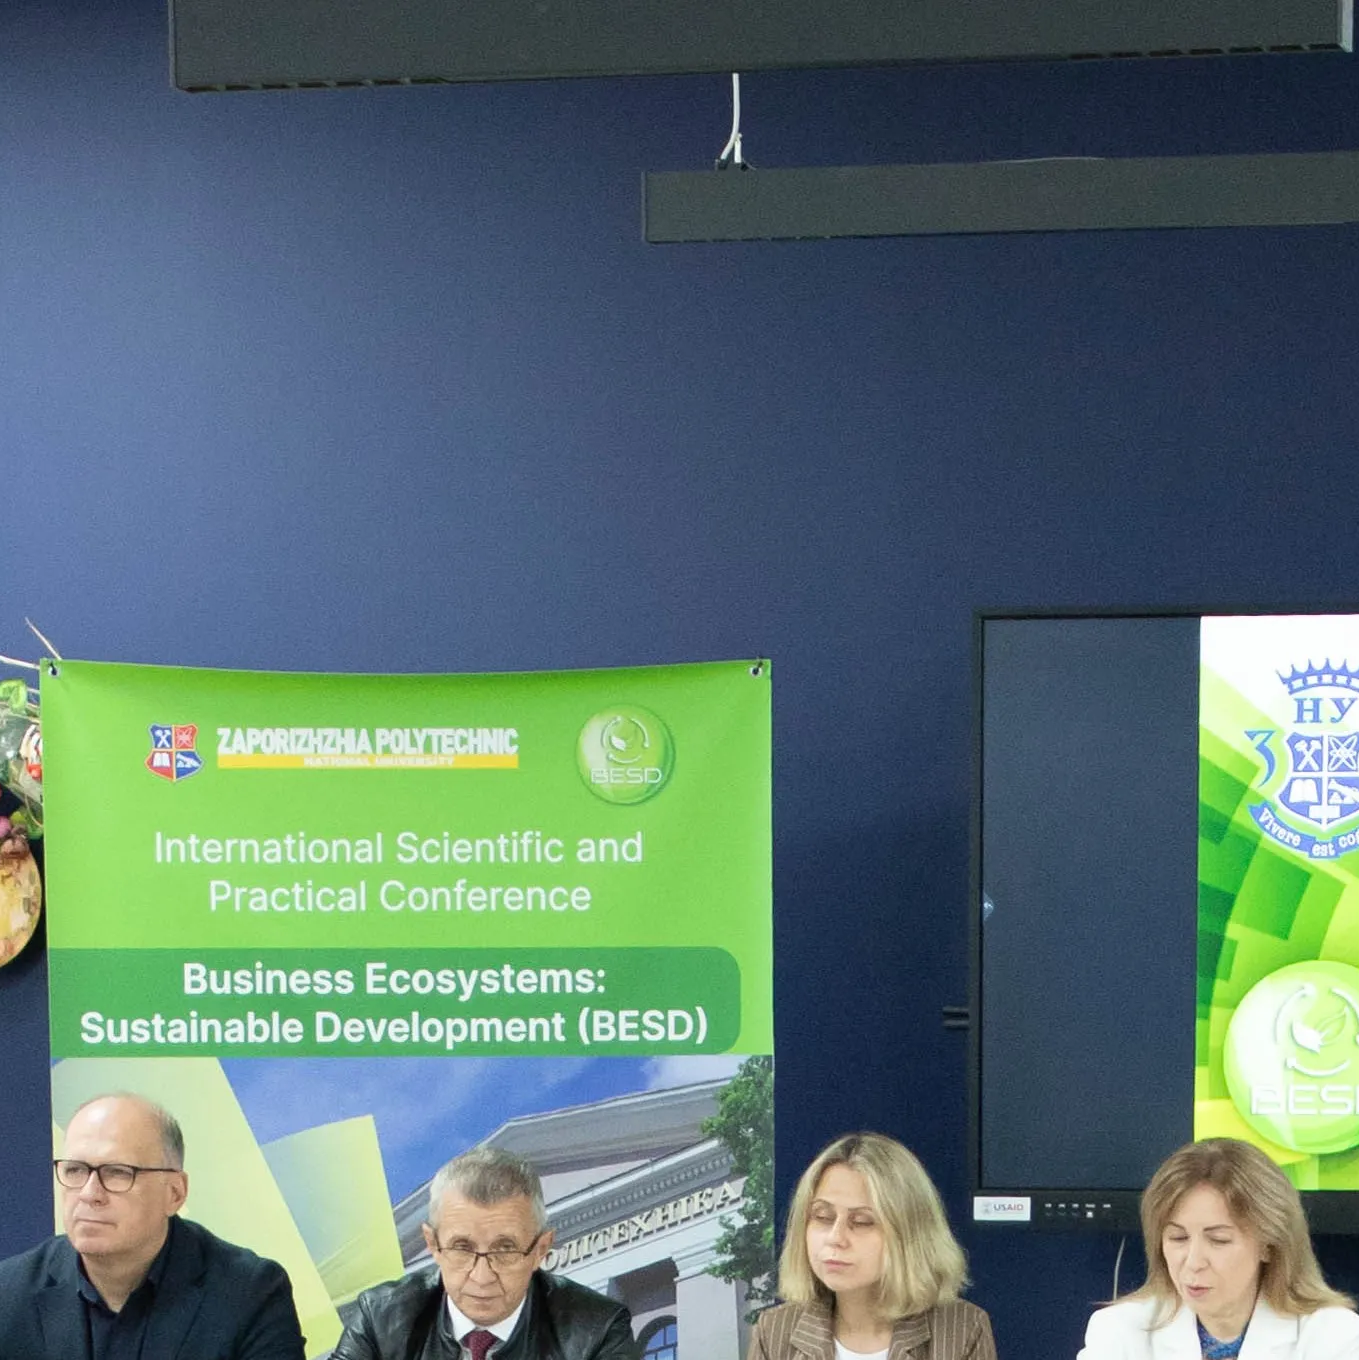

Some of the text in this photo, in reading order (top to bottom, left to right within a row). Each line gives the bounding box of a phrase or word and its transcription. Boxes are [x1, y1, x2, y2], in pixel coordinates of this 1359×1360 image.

[216, 727, 520, 755] ZAPORIZHZHIA POLYTECHNIC
[590, 767, 662, 784] BESD
[154, 830, 643, 864] International Scientific and
[1259, 807, 1302, 847] Vivere
[1311, 843, 1336, 857] est
[209, 878, 592, 912] Practical Conference
[183, 961, 606, 1001] Business Ecosystems:
[80, 1006, 708, 1050] Sustainable Development (BESD)
[993, 1203, 1024, 1211] USAID
[540, 1181, 746, 1272] ОЛІТЕХНІКА
